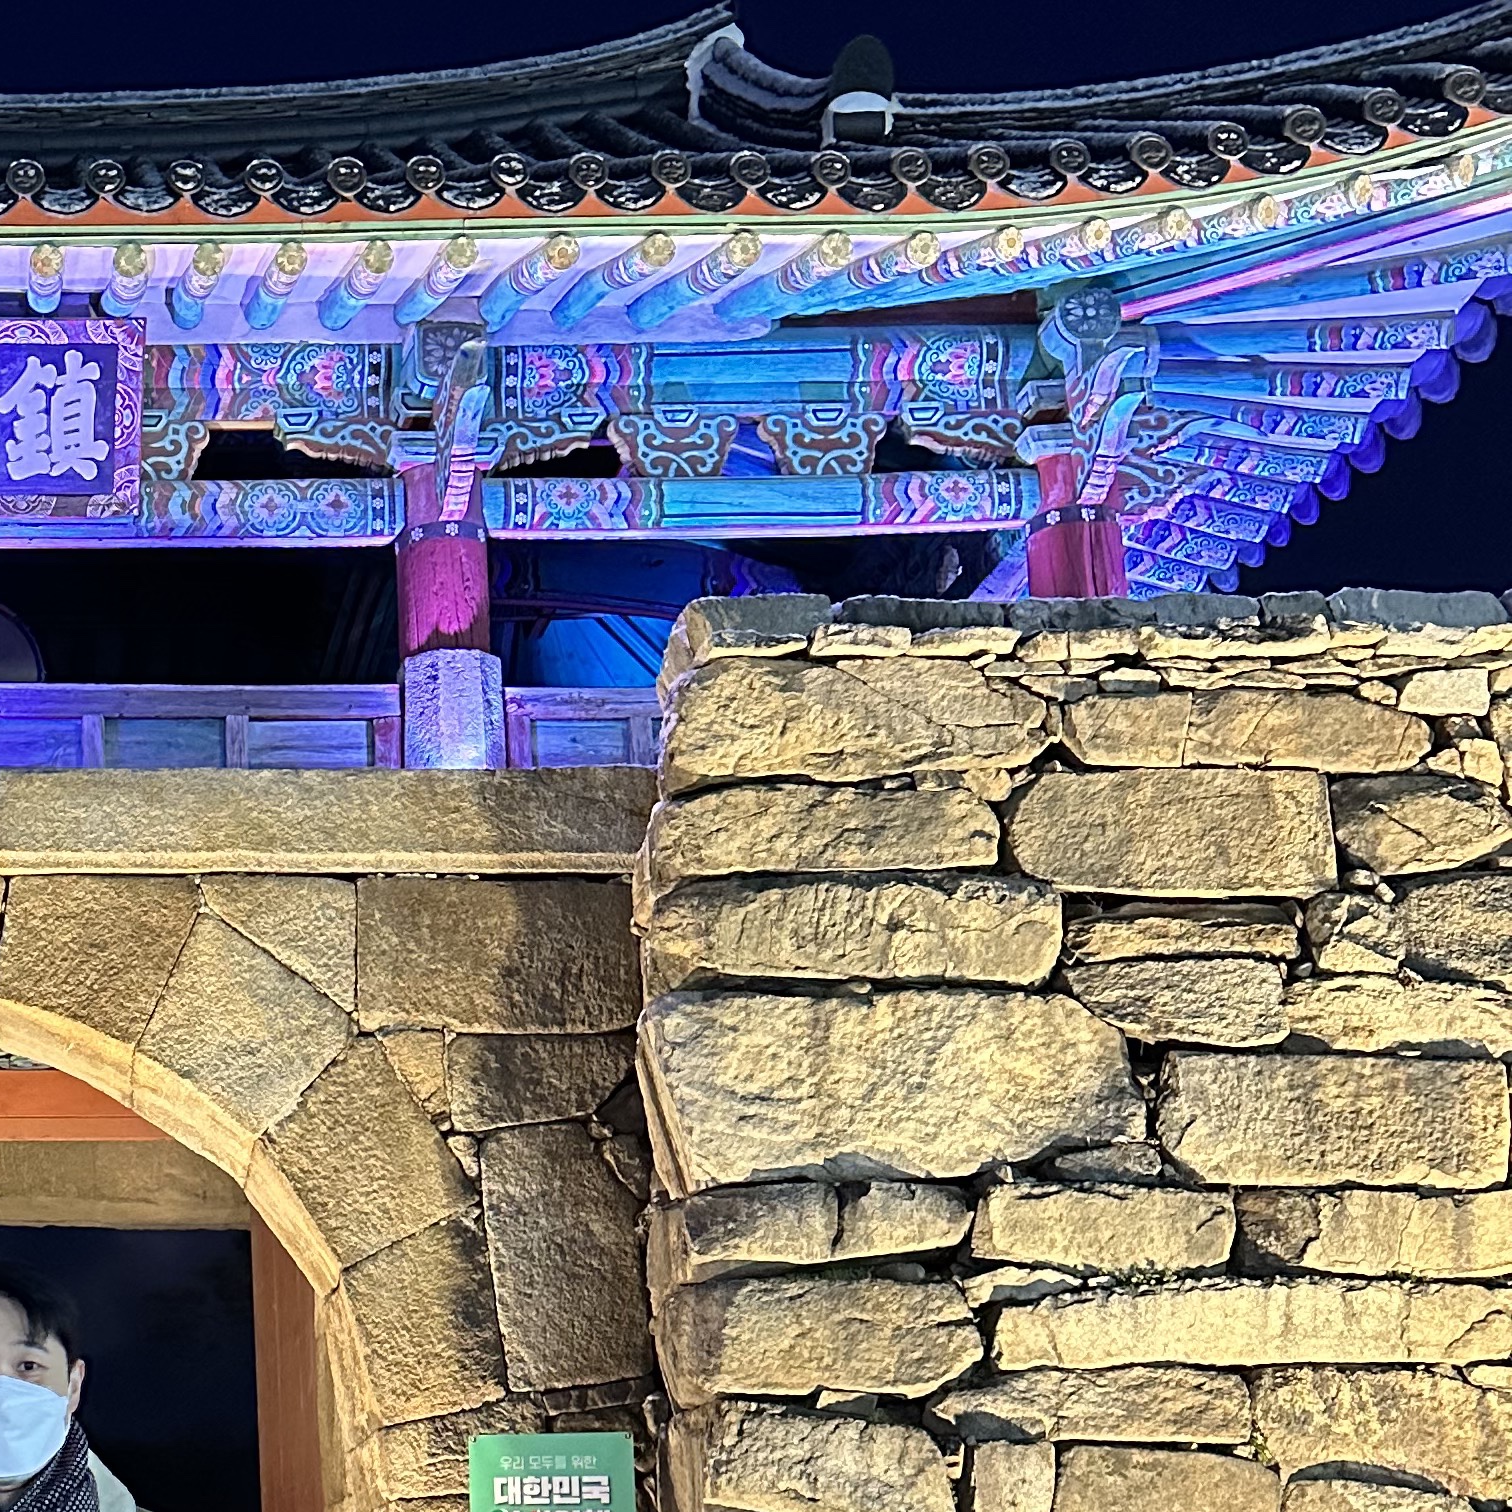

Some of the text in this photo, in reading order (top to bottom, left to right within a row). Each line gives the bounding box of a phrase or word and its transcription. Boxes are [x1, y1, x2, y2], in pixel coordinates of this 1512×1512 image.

[499, 1455, 525, 1470] 우리
[571, 1455, 598, 1470] 위한
[493, 1475, 611, 1505] 대한민국
